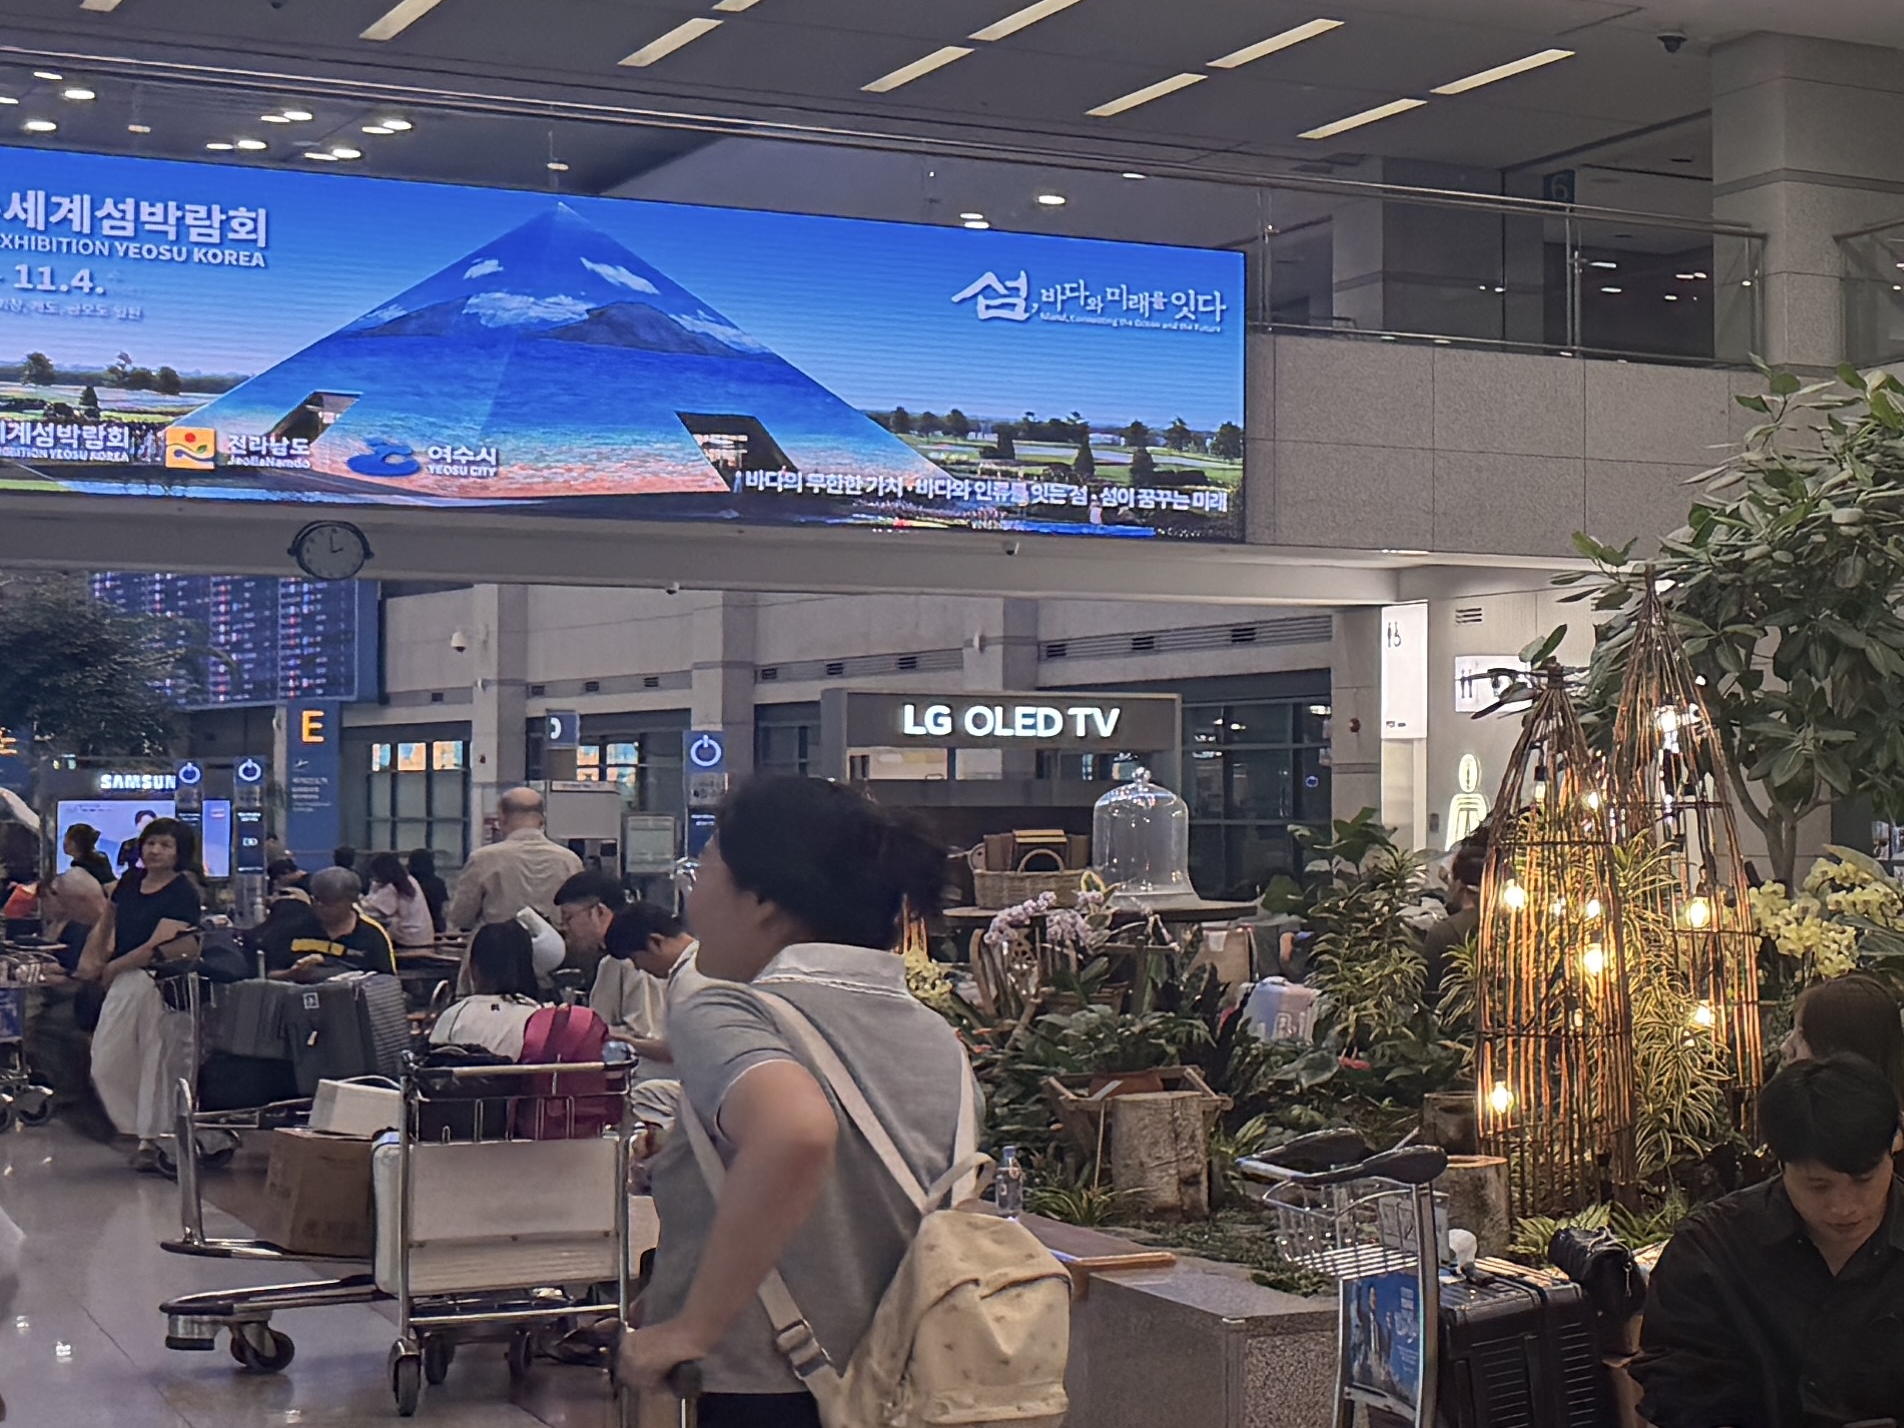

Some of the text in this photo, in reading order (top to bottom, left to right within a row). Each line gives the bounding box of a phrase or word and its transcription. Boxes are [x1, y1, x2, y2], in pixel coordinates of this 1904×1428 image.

[2, 190, 267, 248] 세계섬박람회
[115, 241, 188, 263] YEOSU
[193, 246, 265, 268] KOREA
[13, 263, 106, 295] 11.4.
[1040, 279, 1104, 315] 바다와
[1105, 283, 1168, 319] 미래를
[1171, 289, 1227, 323] 잇다
[228, 434, 310, 456] 전라남도
[428, 445, 497, 465] 여수시
[428, 464, 497, 477] YEOSU CITY
[745, 470, 803, 493] 바다의
[805, 472, 863, 496] 무한한
[866, 475, 903, 498] 가치
[916, 478, 972, 500] 바다와
[974, 480, 1028, 502] 인류를
[1100, 487, 1135, 509] 섬이
[1137, 488, 1189, 512] 꿈꾸는
[1193, 489, 1229, 513] 미래
[301, 710, 325, 744] E
[903, 703, 1121, 738] LG OLED TV
